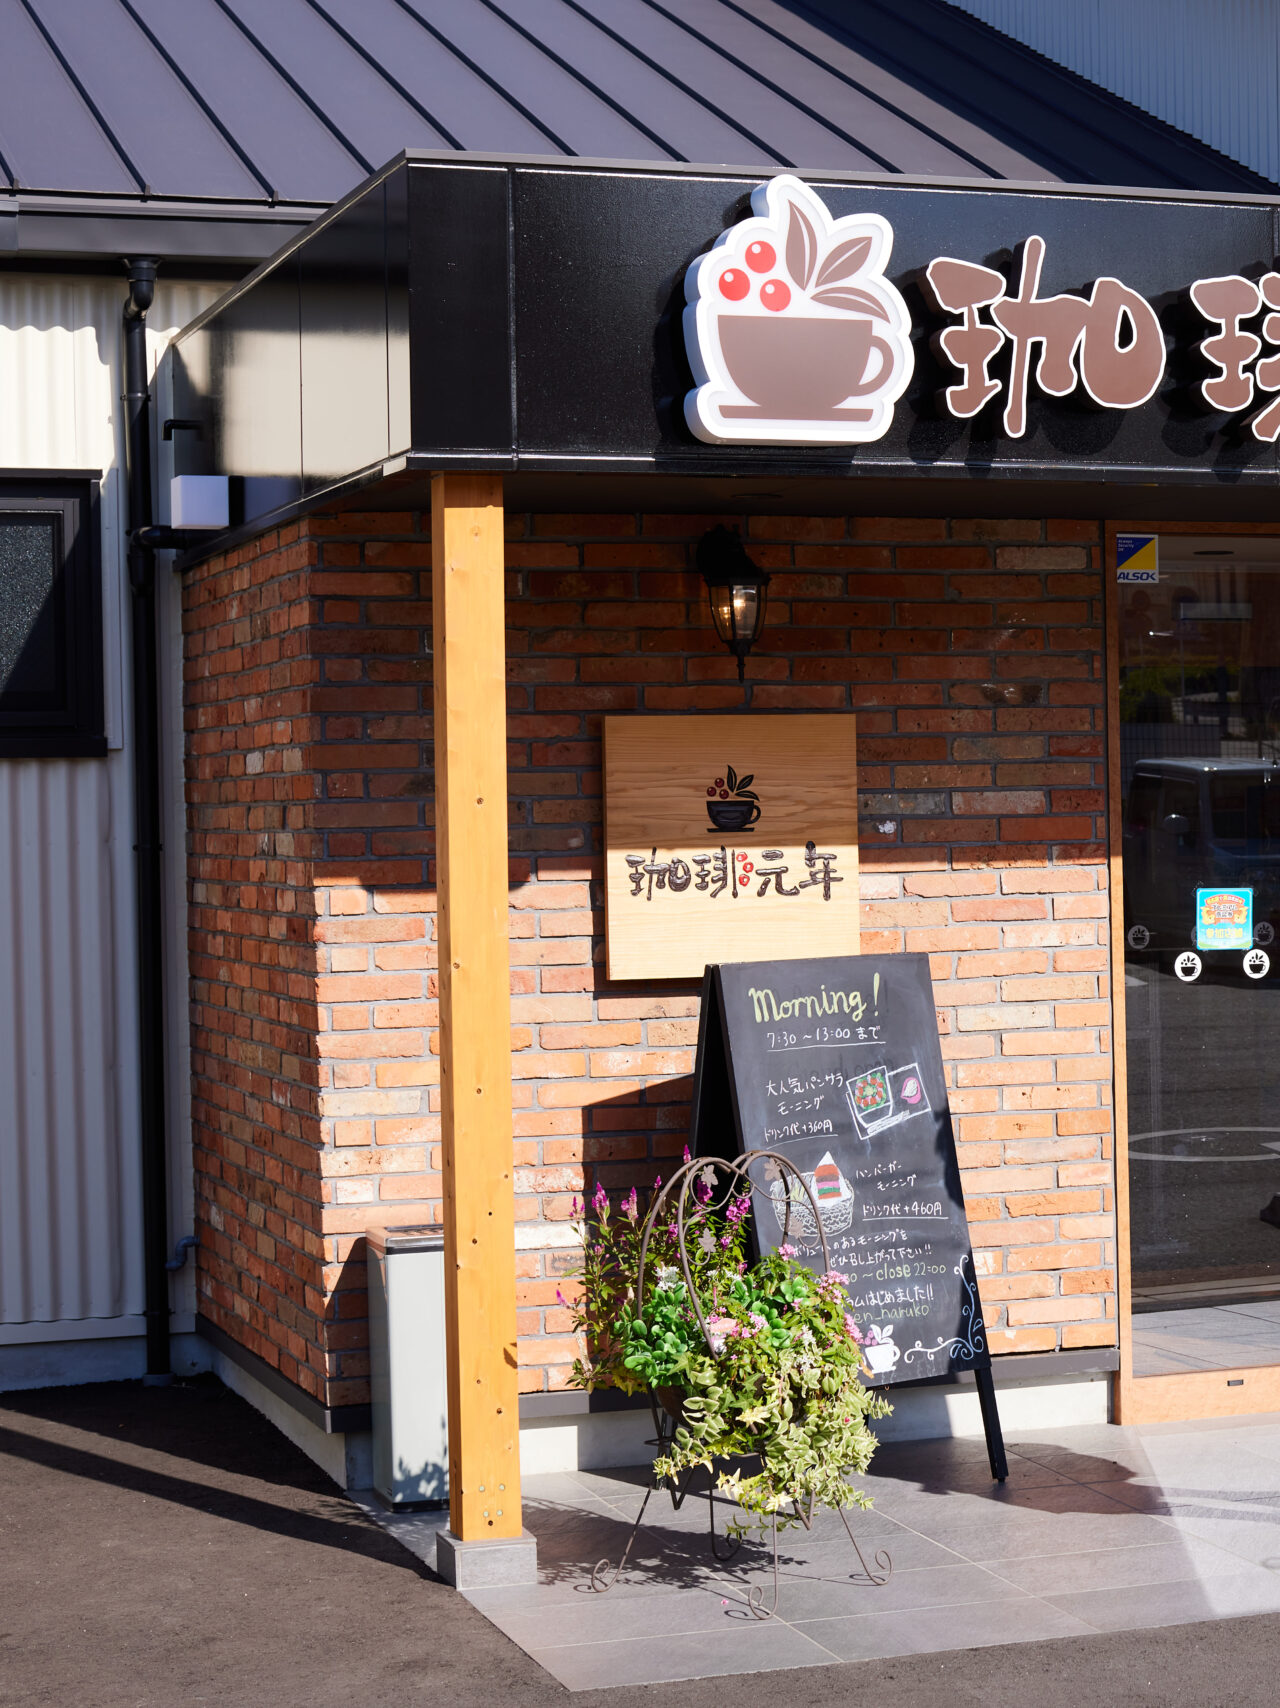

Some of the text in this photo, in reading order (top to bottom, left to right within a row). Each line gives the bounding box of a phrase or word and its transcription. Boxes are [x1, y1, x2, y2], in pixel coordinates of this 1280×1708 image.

[1117, 571, 1156, 581] ALSOK
[625, 841, 843, 901] 珈琲元年
[765, 1073, 843, 1096] 大人気パンサラ
[777, 1095, 825, 1115] モーニング
[877, 1173, 917, 1191] モーニング
[876, 1263, 911, 1281] close
